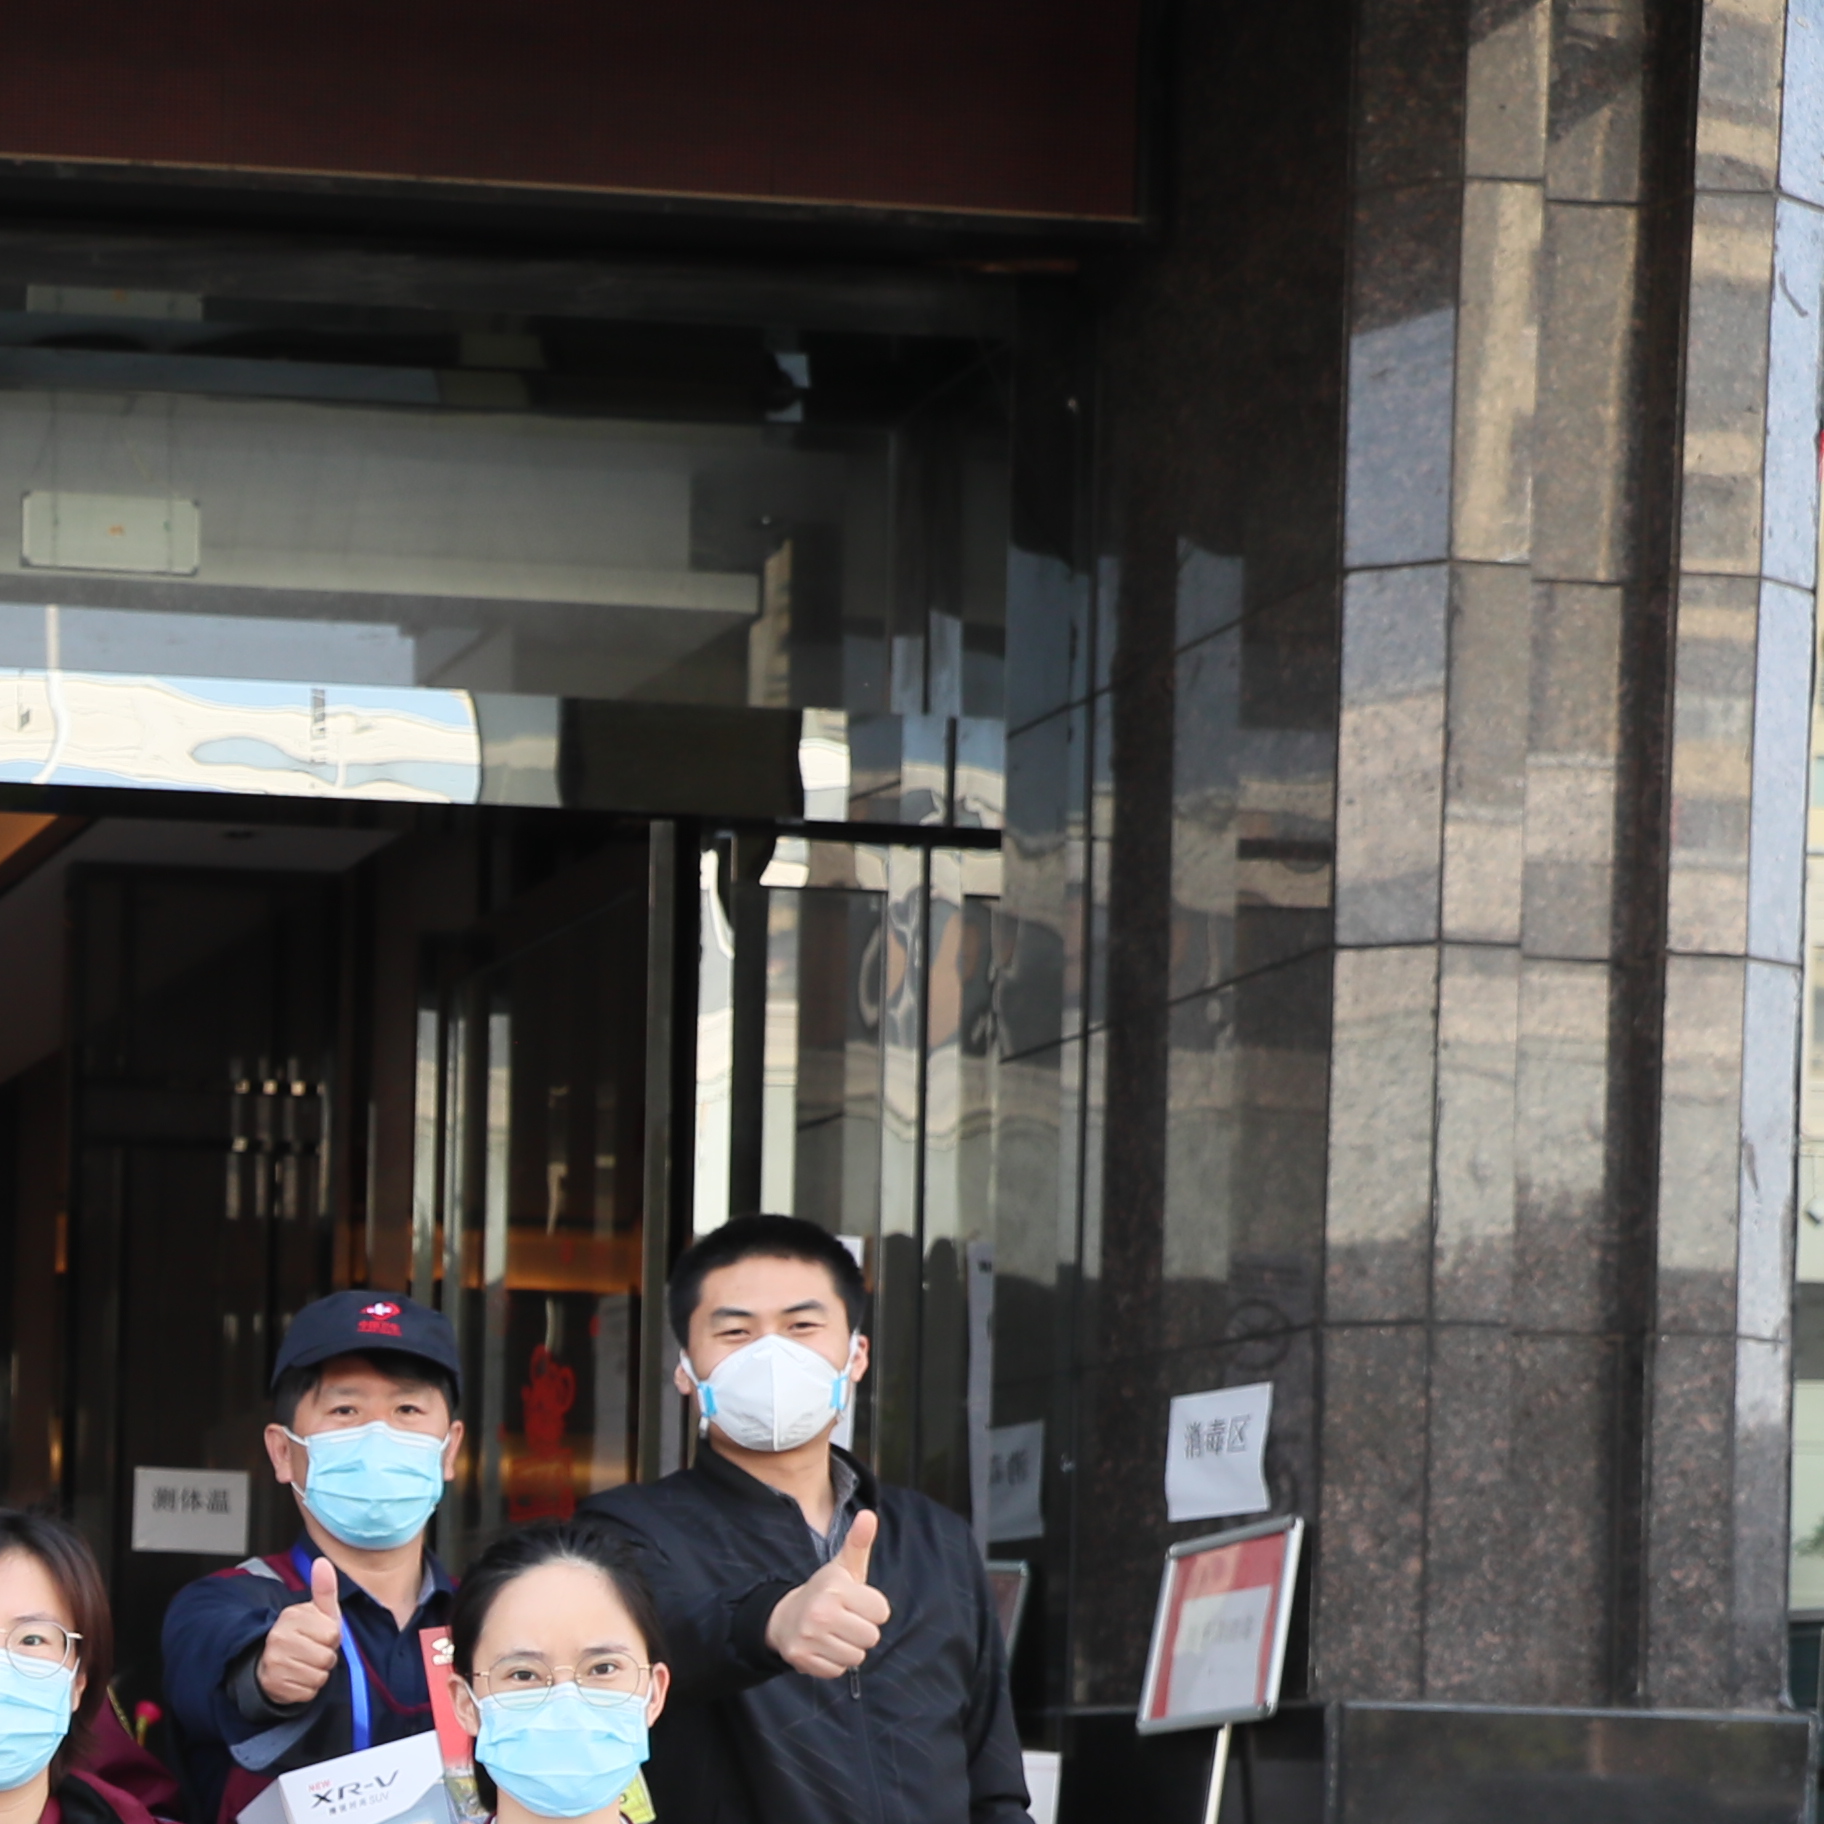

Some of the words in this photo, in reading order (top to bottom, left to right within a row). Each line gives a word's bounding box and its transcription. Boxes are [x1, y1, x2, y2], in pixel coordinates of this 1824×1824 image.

[1184, 1413, 1250, 1458] 消毒区
[152, 1486, 230, 1514] 测体温
[311, 1769, 399, 1809] XR-V
